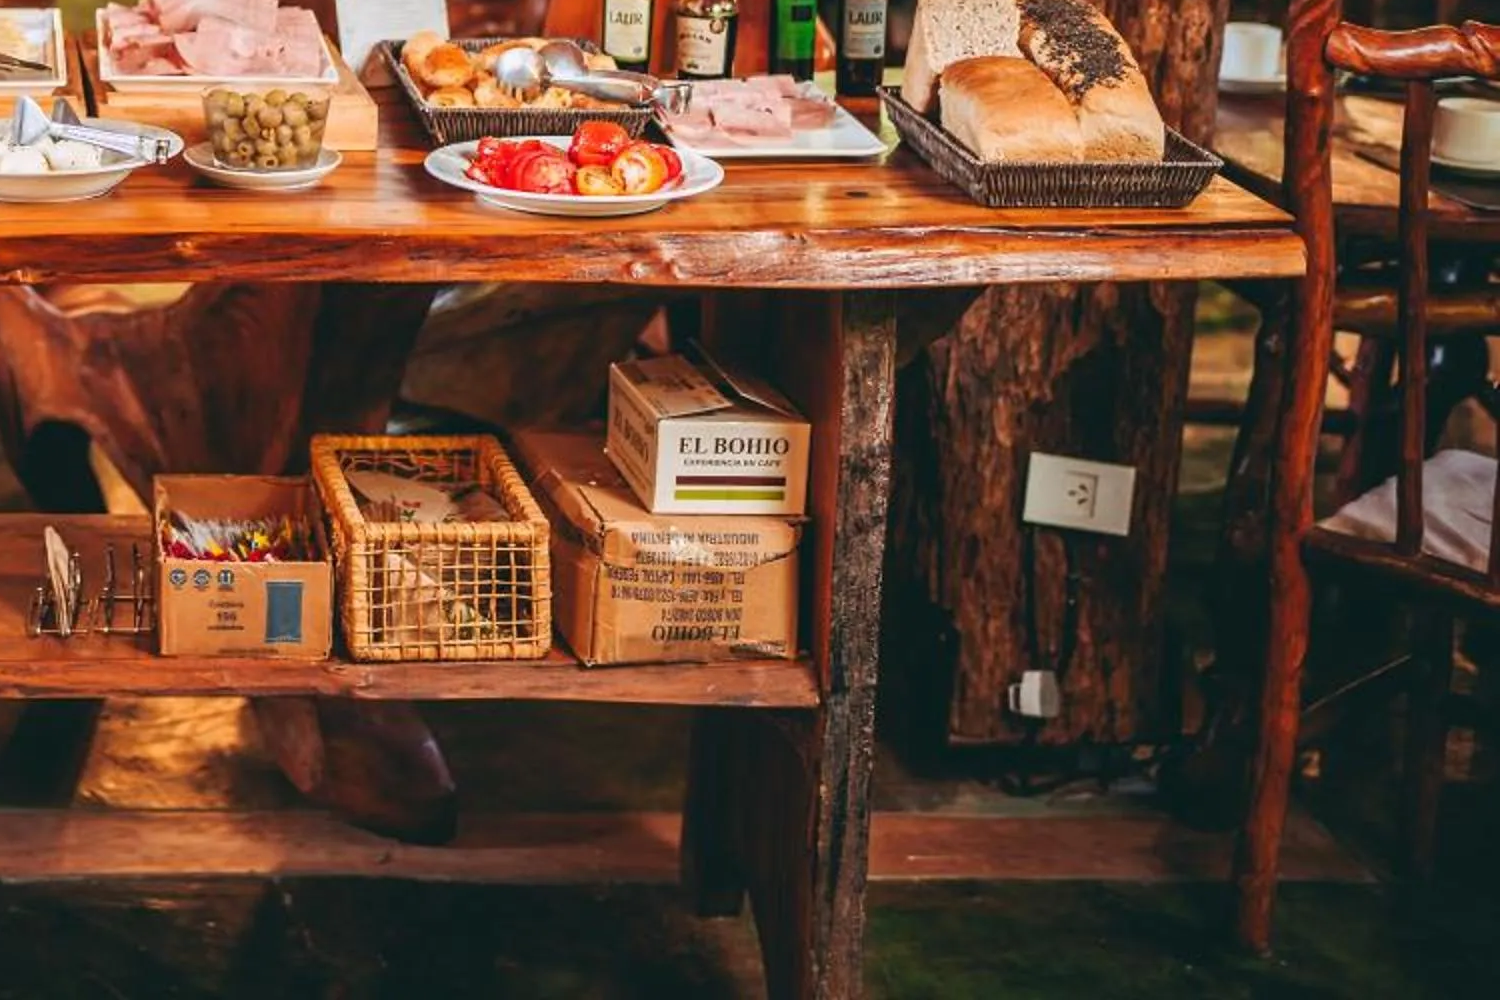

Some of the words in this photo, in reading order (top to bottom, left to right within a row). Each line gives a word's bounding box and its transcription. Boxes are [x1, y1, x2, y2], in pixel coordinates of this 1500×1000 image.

[609, 11, 643, 25] LAUR
[849, 11, 883, 25] LAUR
[678, 437, 708, 454] EL
[714, 437, 790, 455] BOHIO
[697, 532, 759, 545] INDUSTRIA
[651, 625, 714, 641] BOHIO
[720, 625, 740, 640] EL
